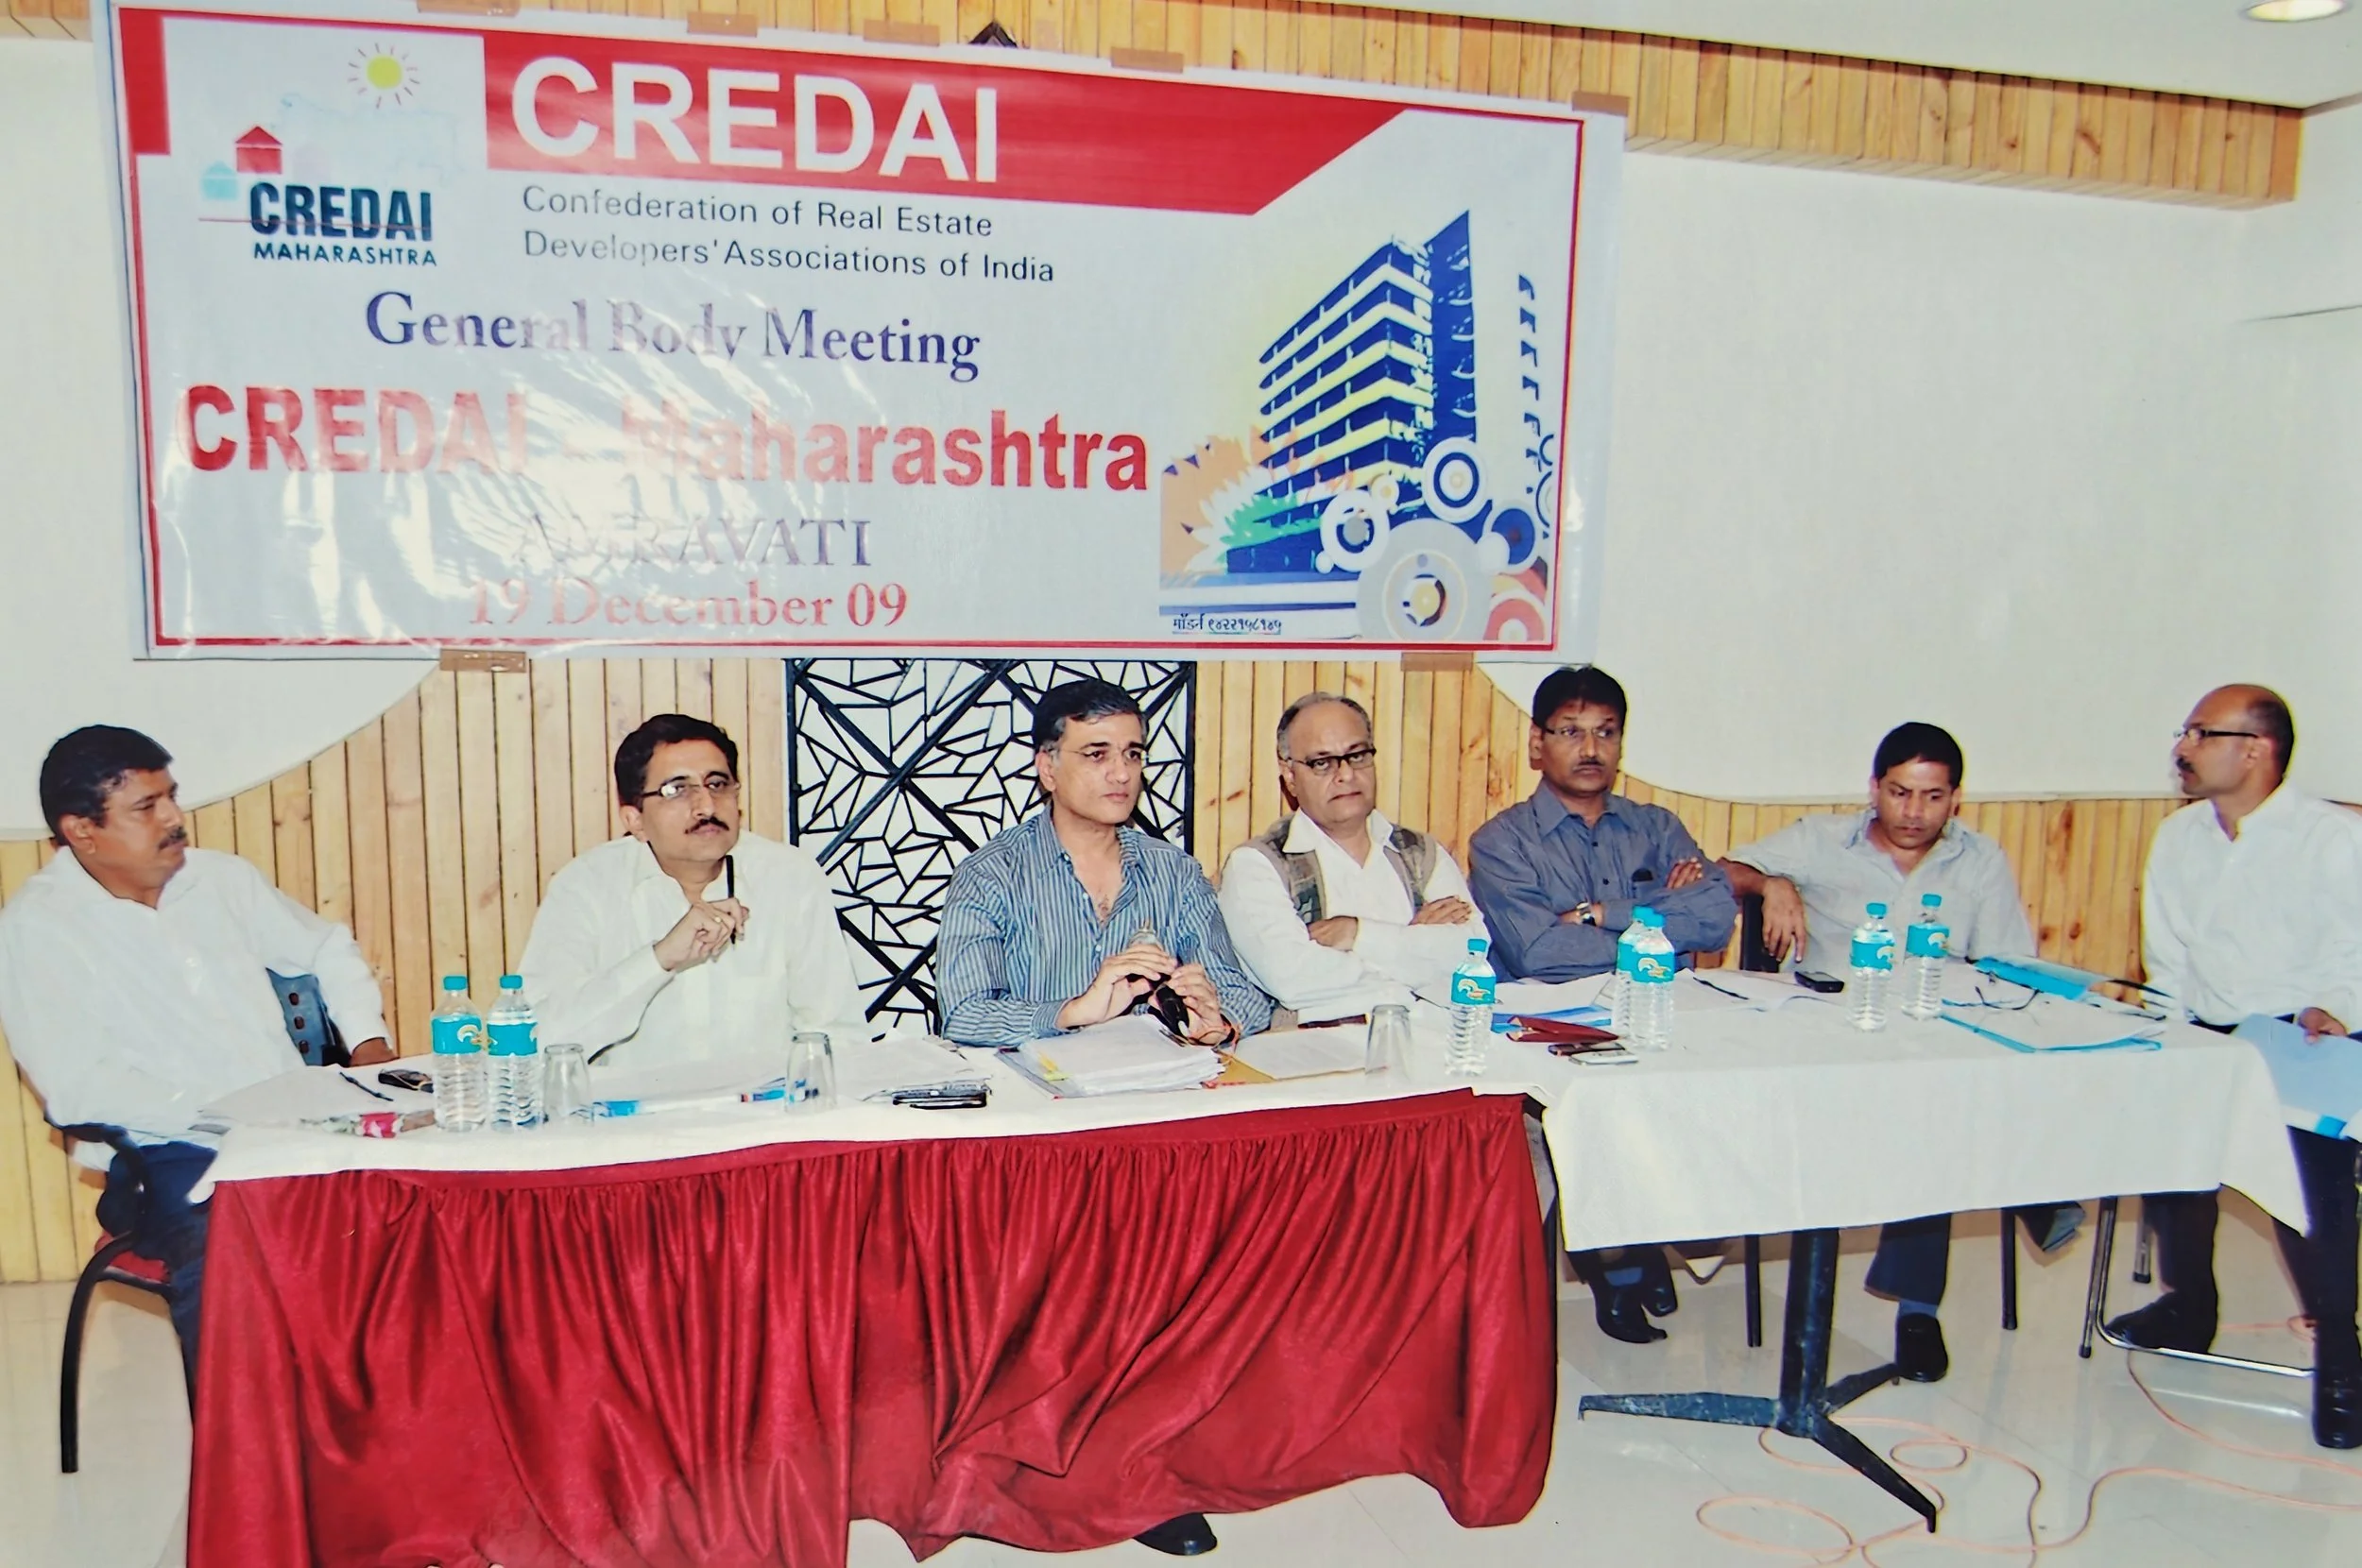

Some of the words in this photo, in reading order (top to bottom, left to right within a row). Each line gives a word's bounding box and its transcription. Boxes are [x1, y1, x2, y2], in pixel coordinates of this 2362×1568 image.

[511, 56, 998, 183] CREDAI
[249, 181, 433, 243] CREDAI
[523, 186, 757, 224] Confederation
[772, 201, 801, 226] of
[818, 202, 881, 230] Real
[899, 207, 992, 238] Estate
[253, 242, 436, 267] MAHARASHTRA
[940, 252, 969, 278] of
[984, 255, 1053, 282] India
[366, 290, 588, 350] General
[608, 299, 746, 362] Body
[763, 308, 981, 383] Meeting
[178, 383, 527, 473] CREDAI
[470, 576, 531, 625] 19
[547, 574, 833, 627] December
[847, 582, 908, 627] 09
